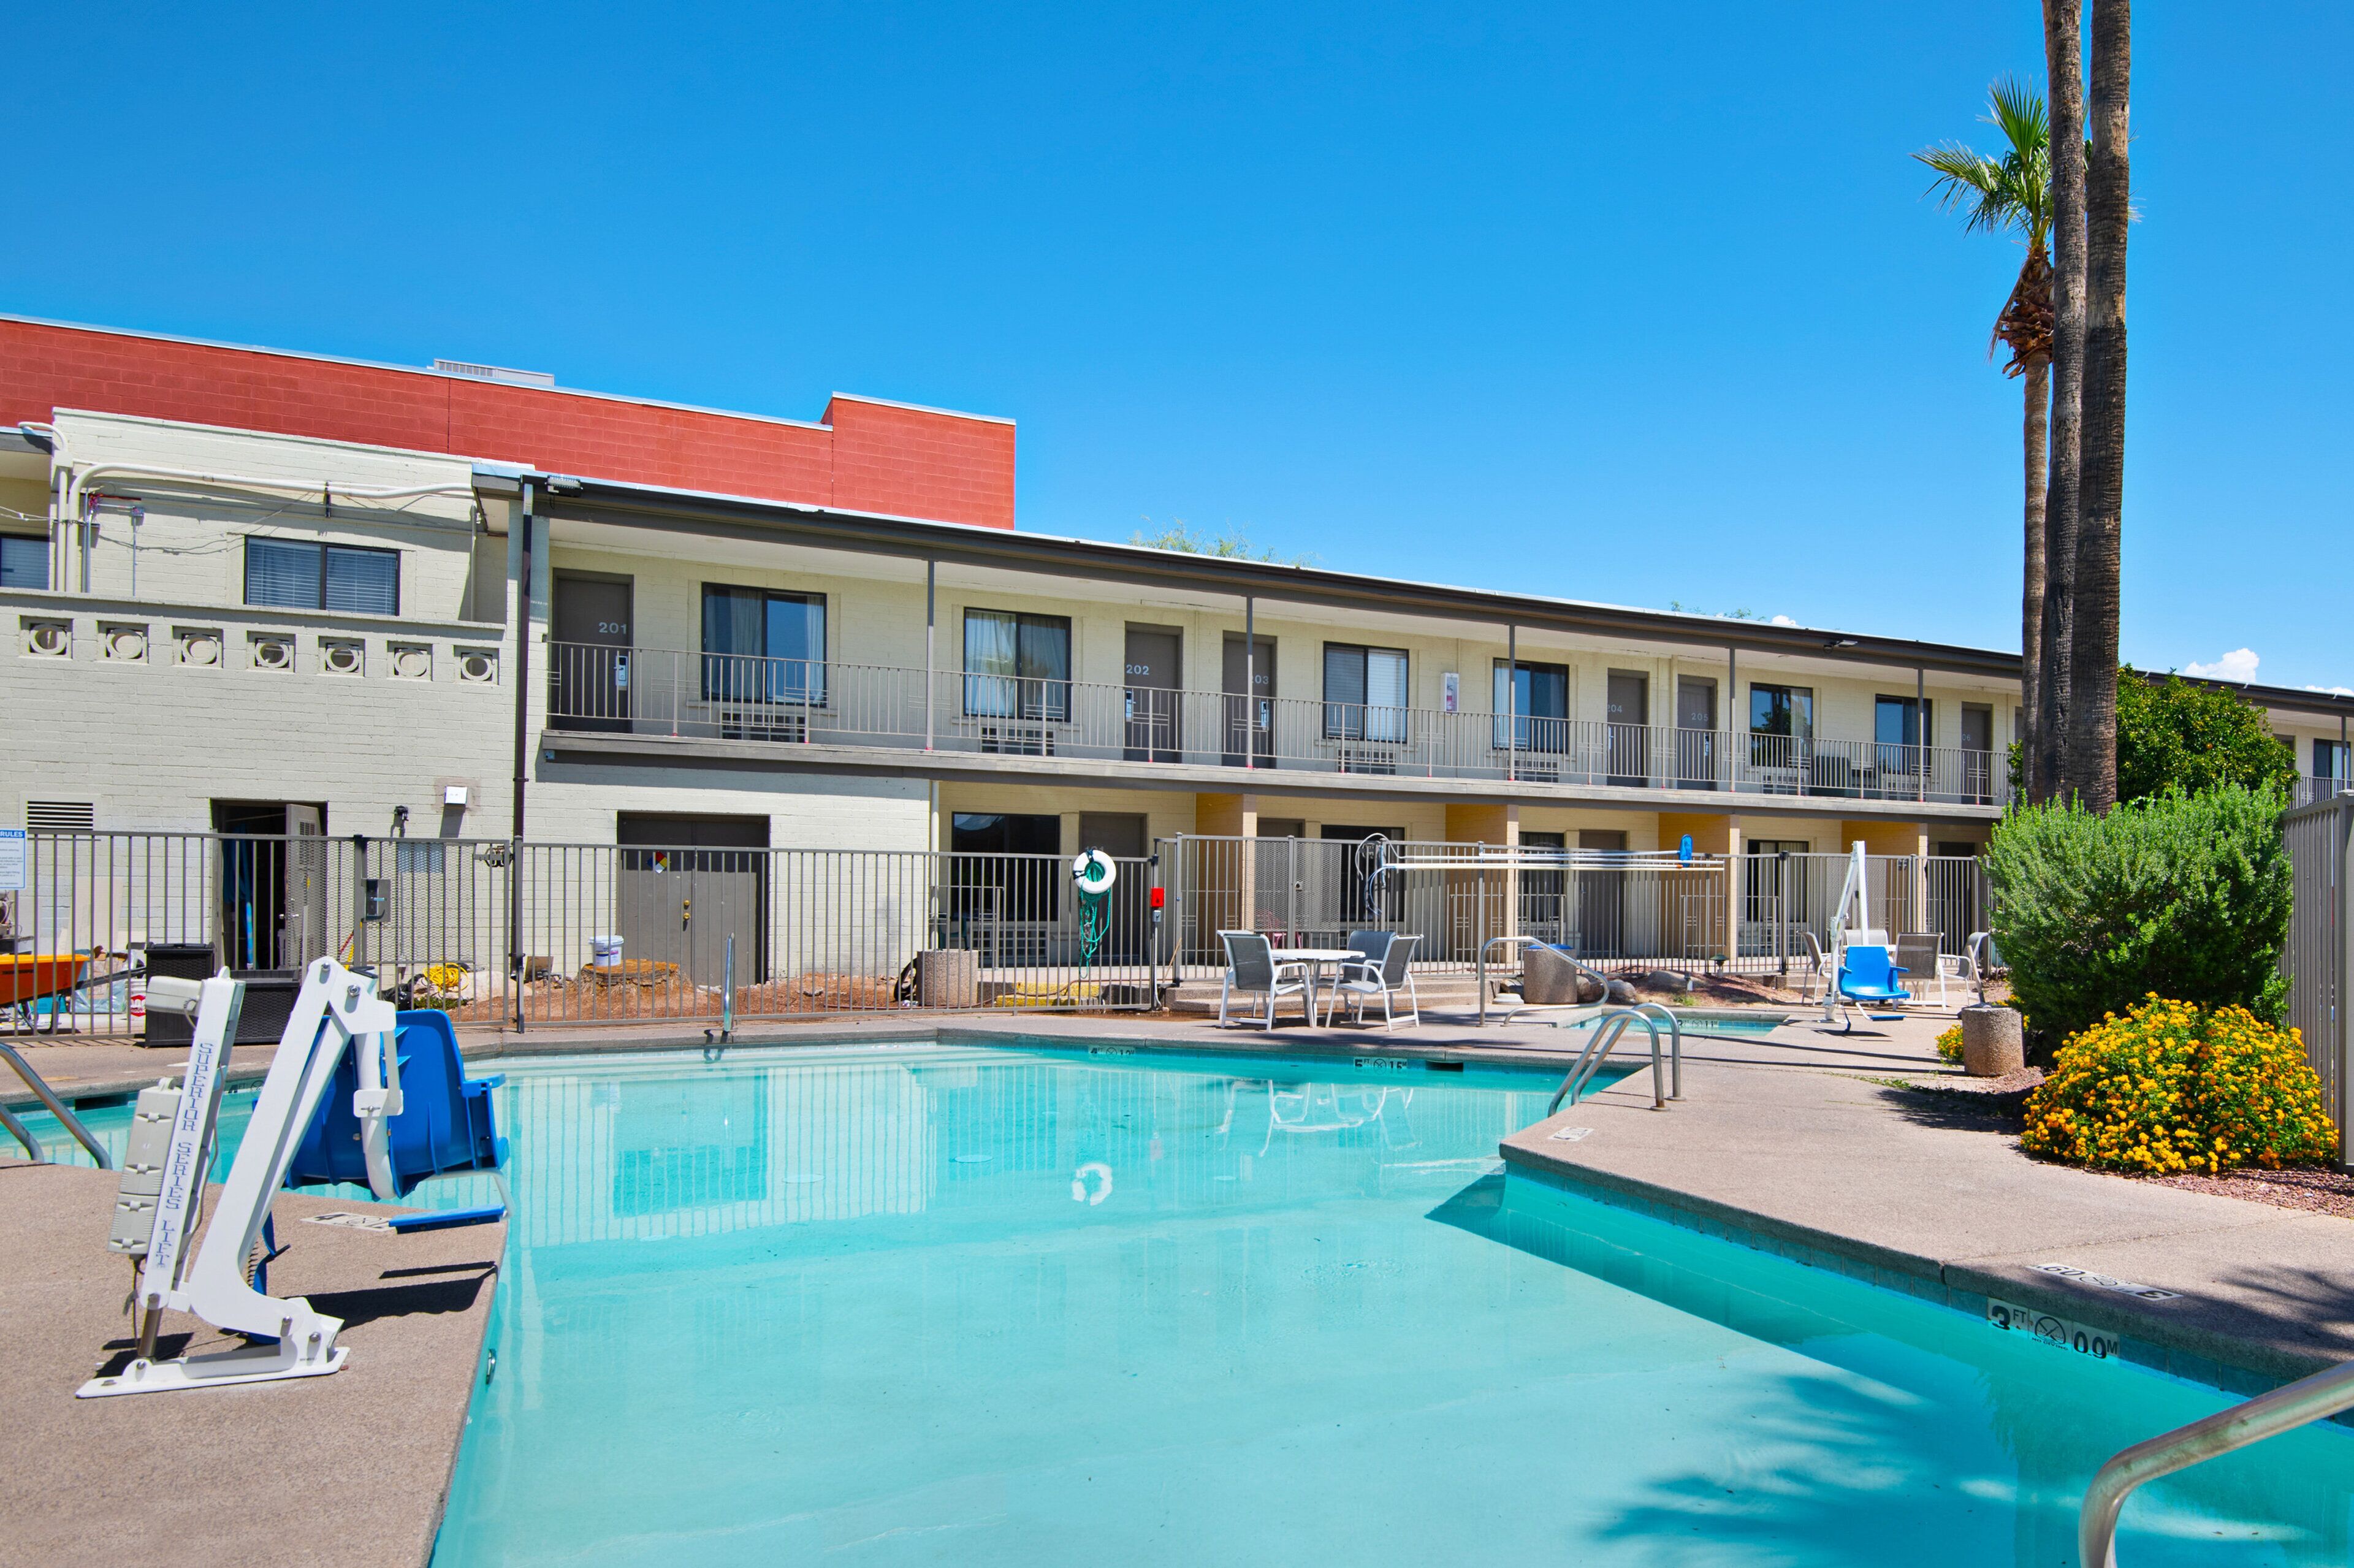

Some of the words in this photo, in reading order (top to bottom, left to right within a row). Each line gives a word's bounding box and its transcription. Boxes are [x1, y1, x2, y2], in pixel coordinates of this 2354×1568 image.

[598, 622, 627, 634] 201
[1126, 664, 1149, 675] 202
[1252, 675, 1269, 685] 03
[1691, 712, 1708, 721] 205
[1962, 733, 1971, 742] 06
[181, 1043, 213, 1132] SUPERIOR
[166, 1142, 192, 1209] SERIES
[156, 1219, 175, 1265] LIFT
[1992, 1305, 2011, 1330] 3
[2013, 1309, 2027, 1323] FT
